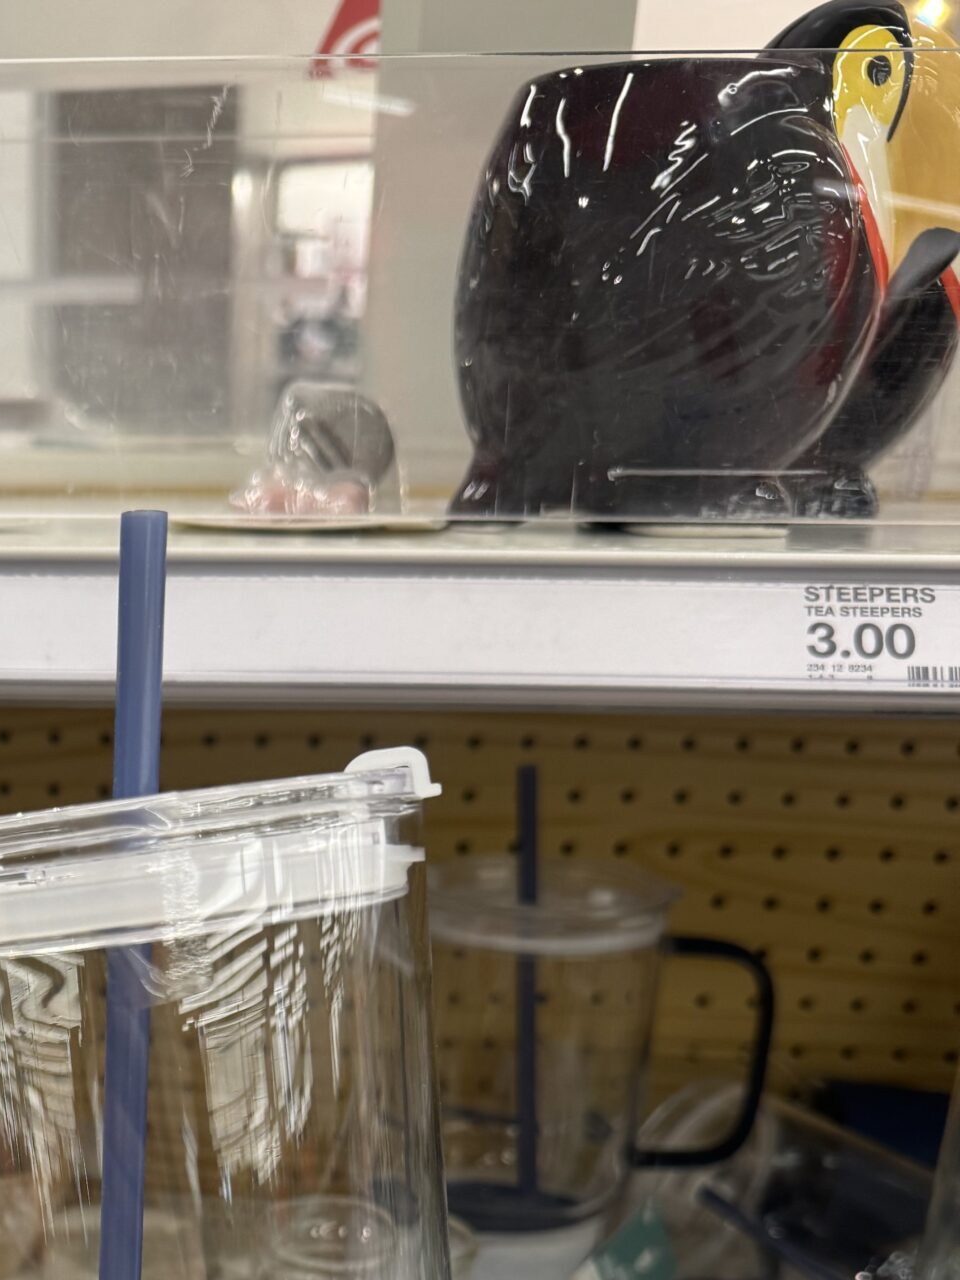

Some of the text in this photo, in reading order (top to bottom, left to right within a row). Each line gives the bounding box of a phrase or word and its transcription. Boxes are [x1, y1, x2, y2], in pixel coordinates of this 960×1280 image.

[804, 585, 936, 604] STEEPERS
[805, 605, 922, 618] TEA STEEPERS
[806, 621, 916, 660] 3.00
